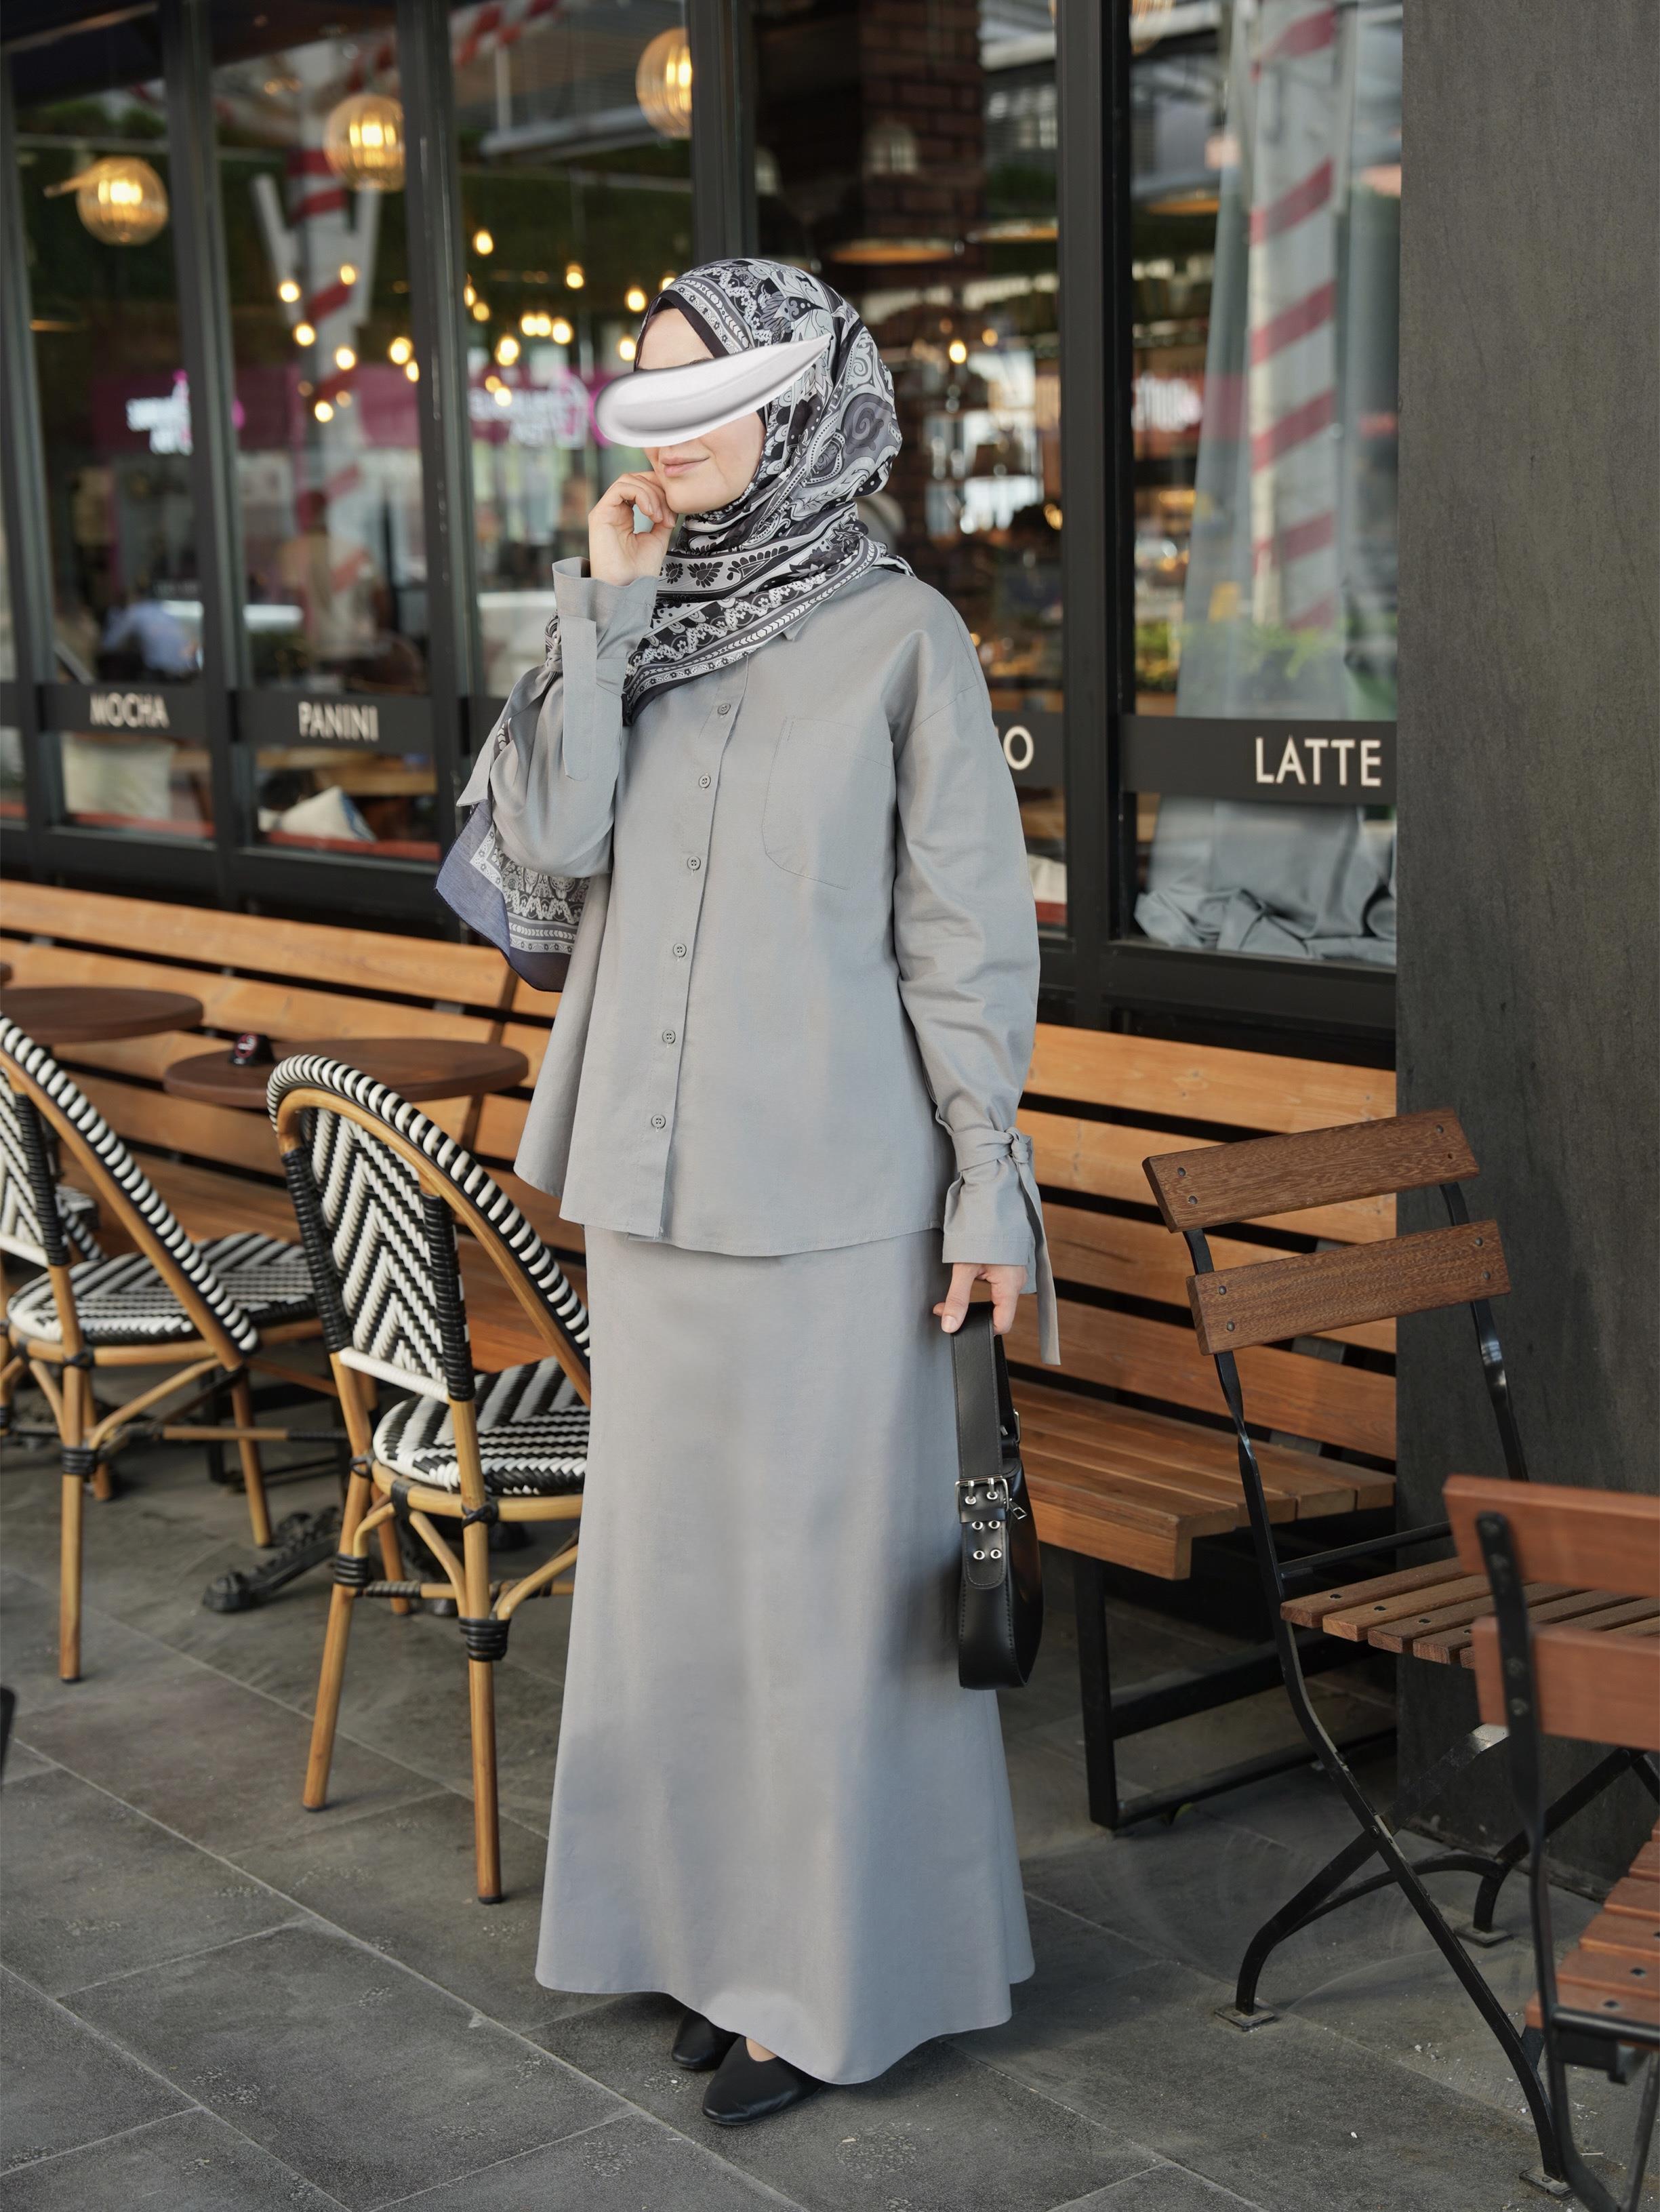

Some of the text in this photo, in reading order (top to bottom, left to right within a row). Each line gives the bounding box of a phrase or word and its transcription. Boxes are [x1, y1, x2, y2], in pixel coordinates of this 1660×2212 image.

[89, 692, 169, 727] MOCHA
[298, 702, 379, 741] PANINI
[994, 725, 1034, 770] O
[1255, 736, 1381, 786] LATTE
